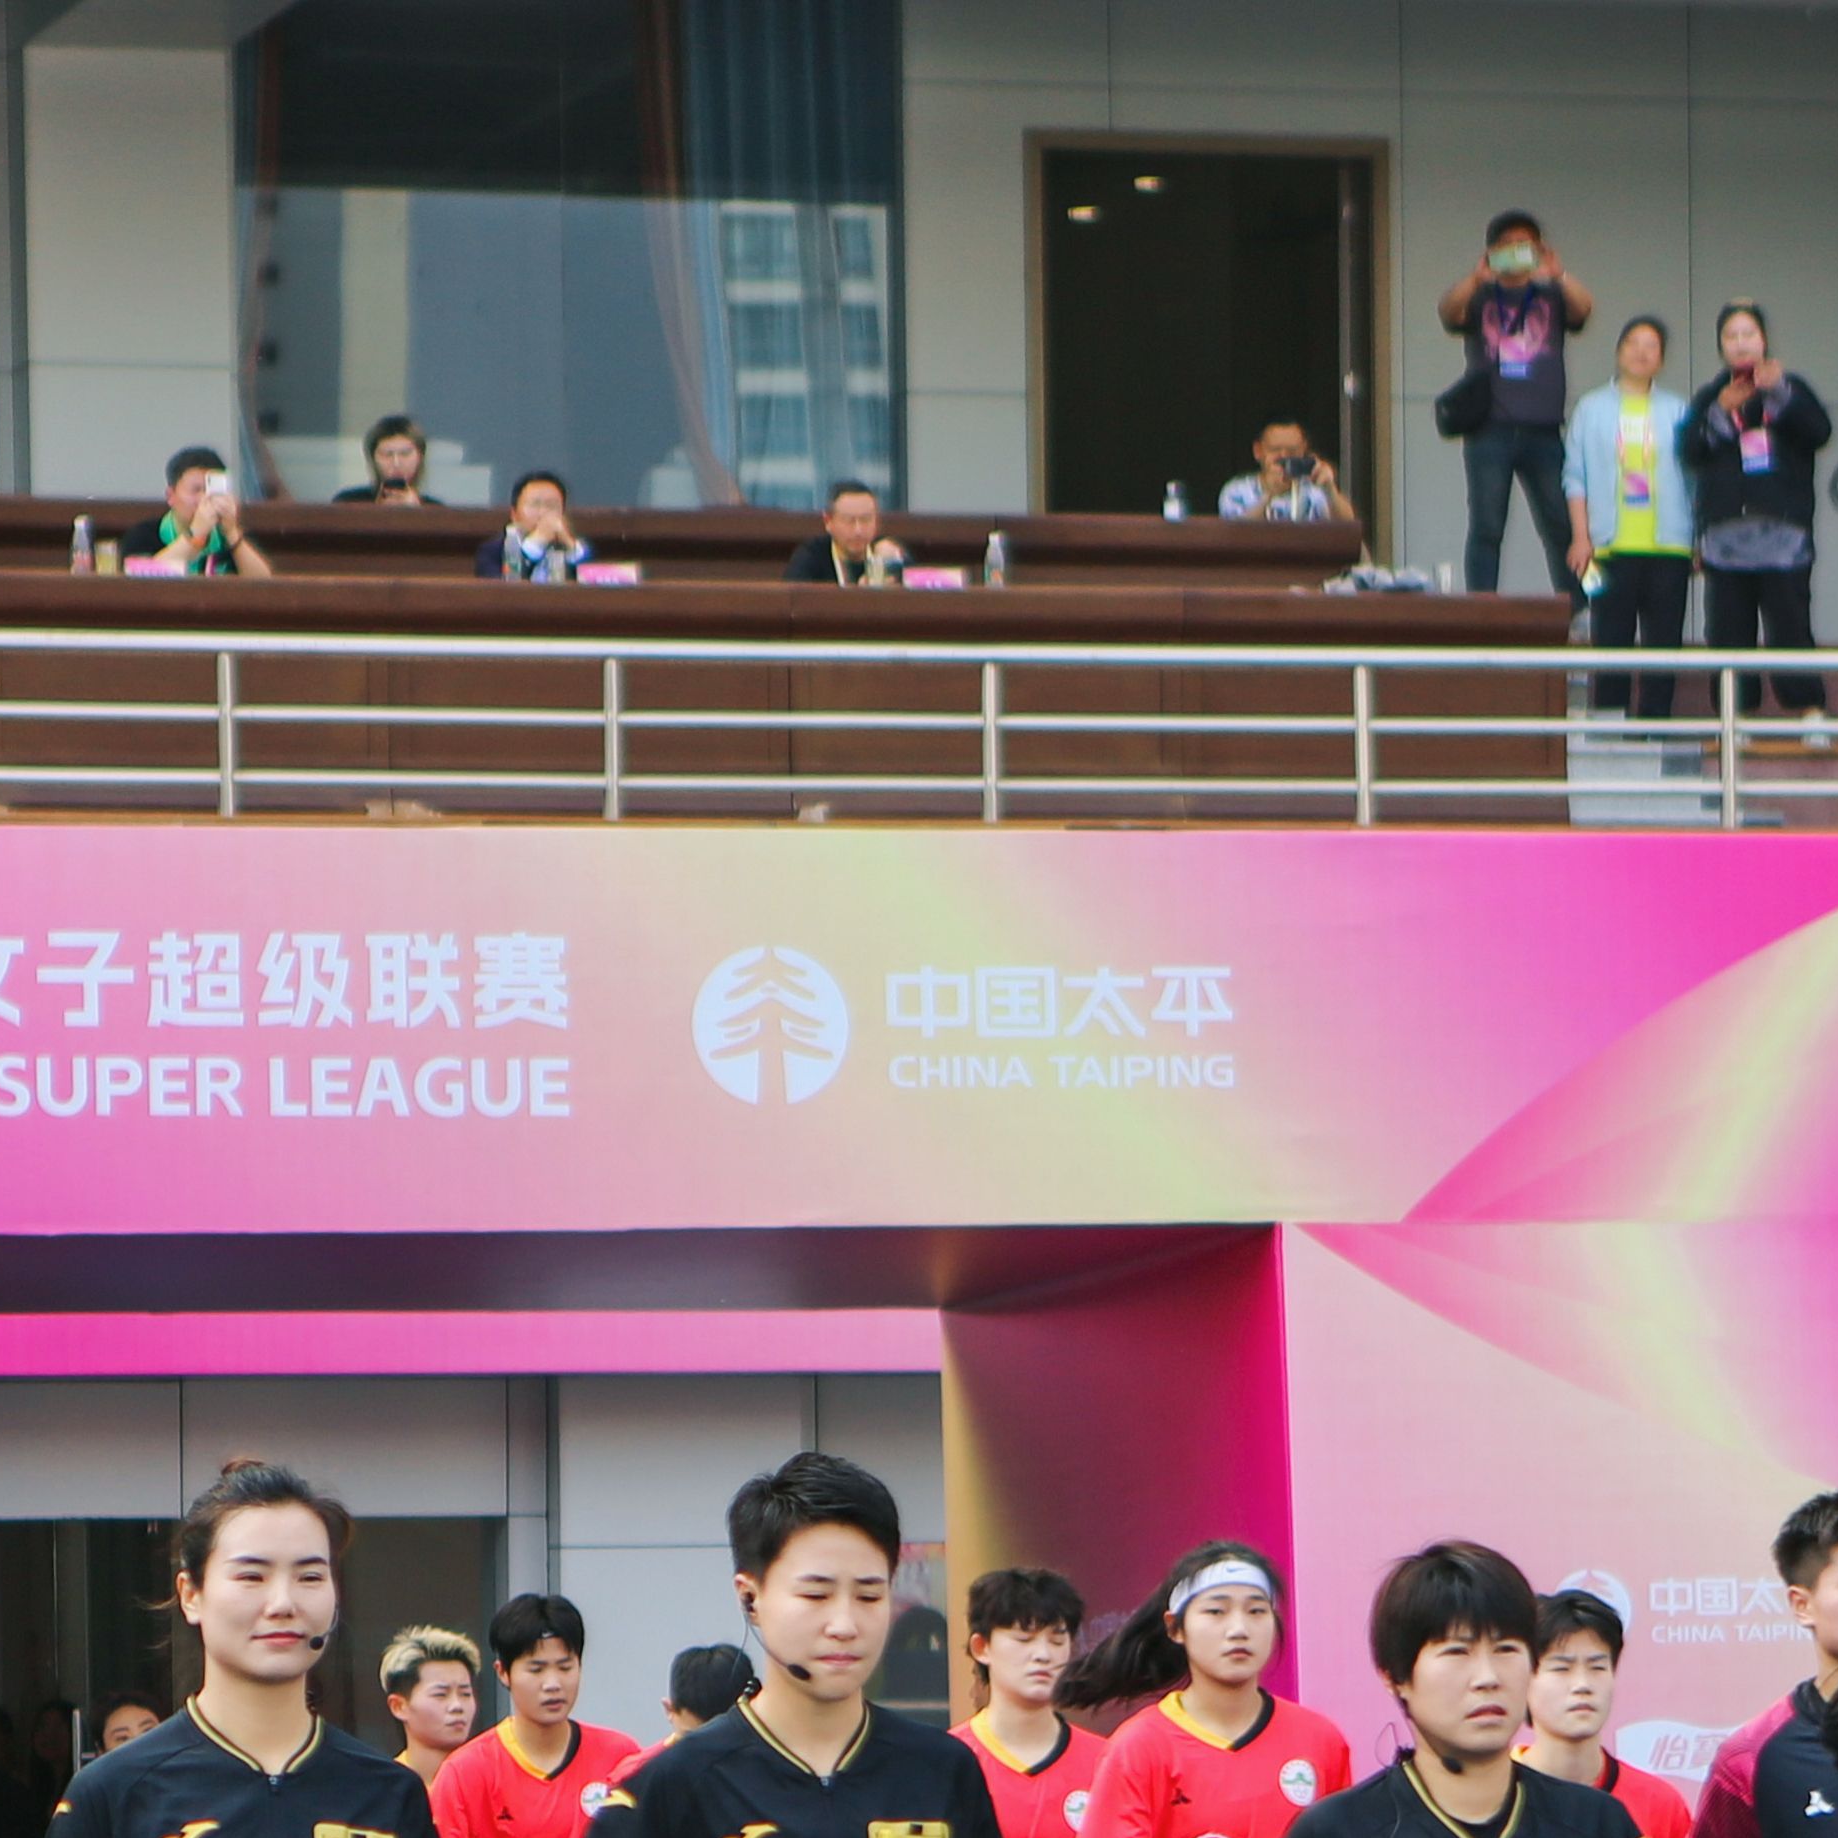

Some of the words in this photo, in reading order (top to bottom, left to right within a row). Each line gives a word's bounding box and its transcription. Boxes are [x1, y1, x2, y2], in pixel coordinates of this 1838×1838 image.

[885, 964, 1234, 1038] 中国太平
[269, 1056, 571, 1118] LEAGUE
[888, 1055, 1032, 1088] CHINA
[1047, 1055, 1236, 1088] TAIPING
[1651, 1625, 1727, 1643] CHINA
[1734, 1625, 1813, 1643] TAIPIN
